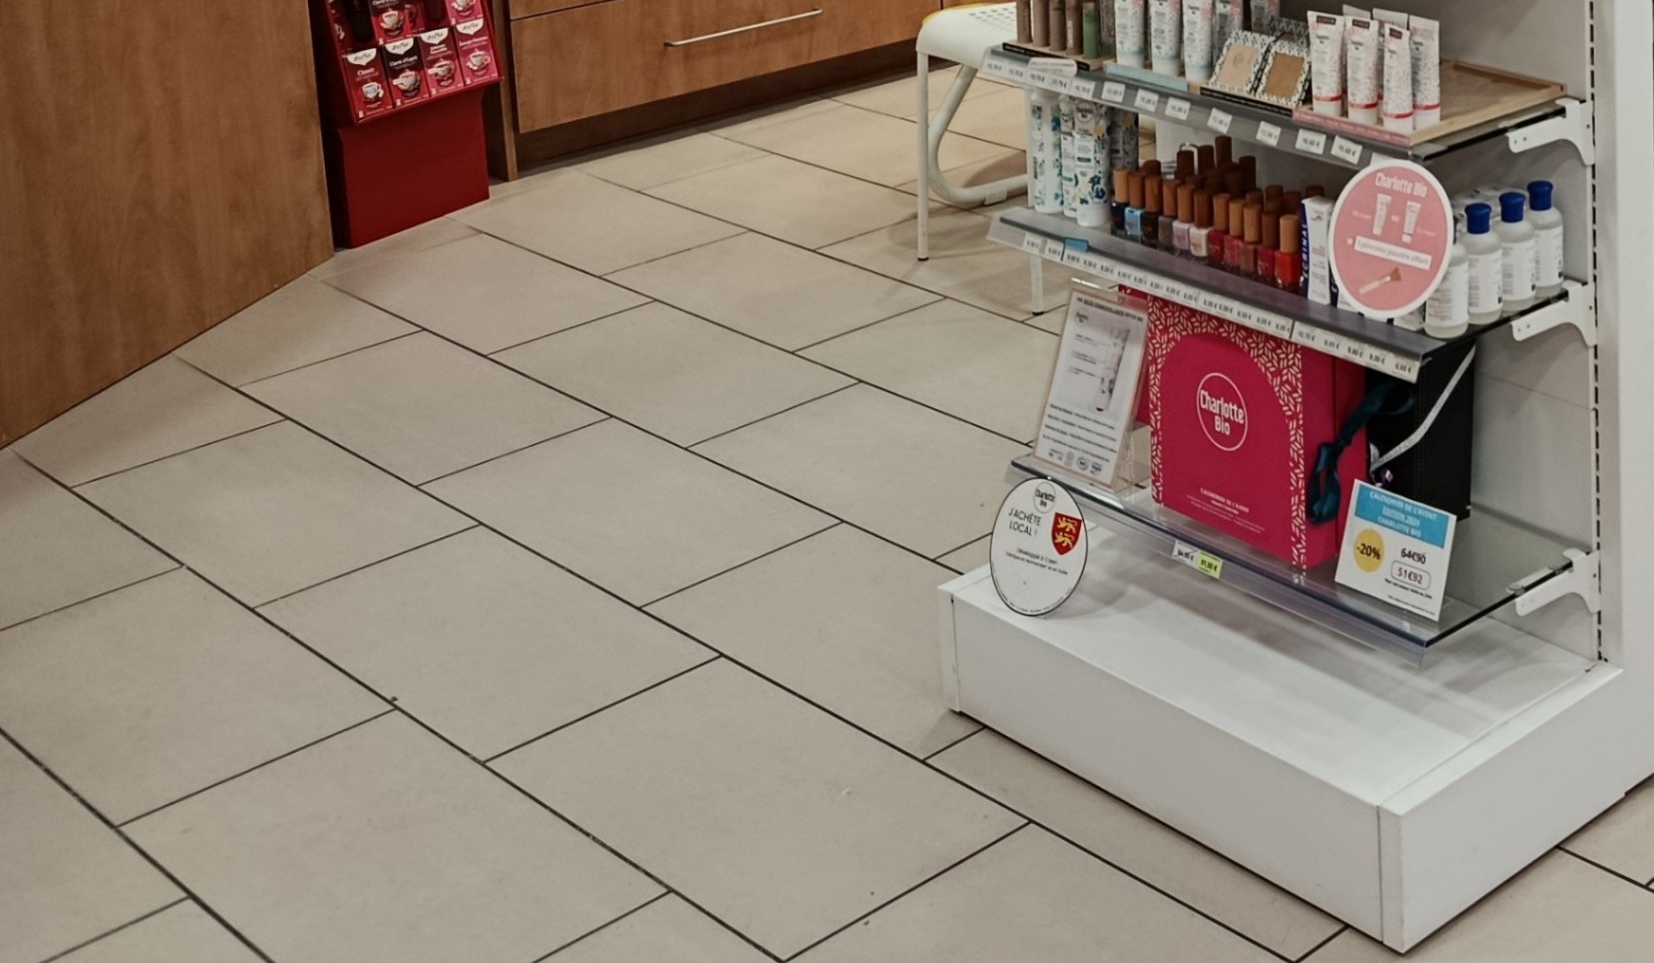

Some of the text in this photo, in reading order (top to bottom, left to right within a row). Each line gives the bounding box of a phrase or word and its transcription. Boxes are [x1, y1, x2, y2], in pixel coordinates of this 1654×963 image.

[1199, 389, 1245, 425] Charlotte
[1214, 418, 1231, 435] Bio
[1008, 507, 1042, 526] J'ACHÈTE
[1009, 522, 1033, 536] LOCAL
[1356, 542, 1381, 560] -20%
[1400, 547, 1426, 565] 64€90
[1397, 567, 1423, 584] 51€92
